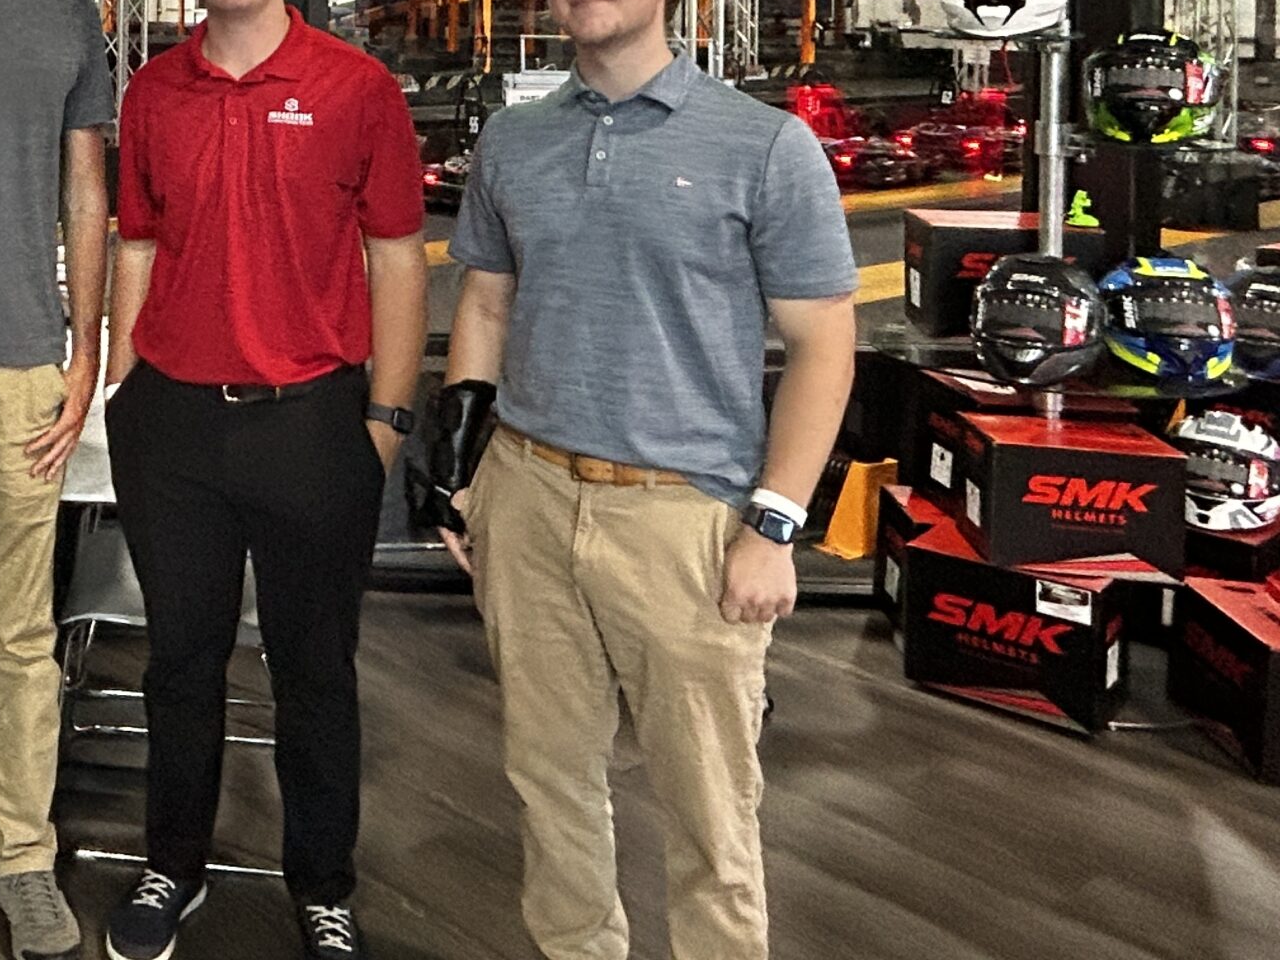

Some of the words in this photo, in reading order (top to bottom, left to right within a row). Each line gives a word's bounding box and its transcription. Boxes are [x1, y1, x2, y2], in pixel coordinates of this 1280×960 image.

[1022, 474, 1159, 514] SMK
[1051, 508, 1127, 526] HELMETS
[927, 592, 1075, 655] SMK
[954, 631, 1039, 665] HELMETS
